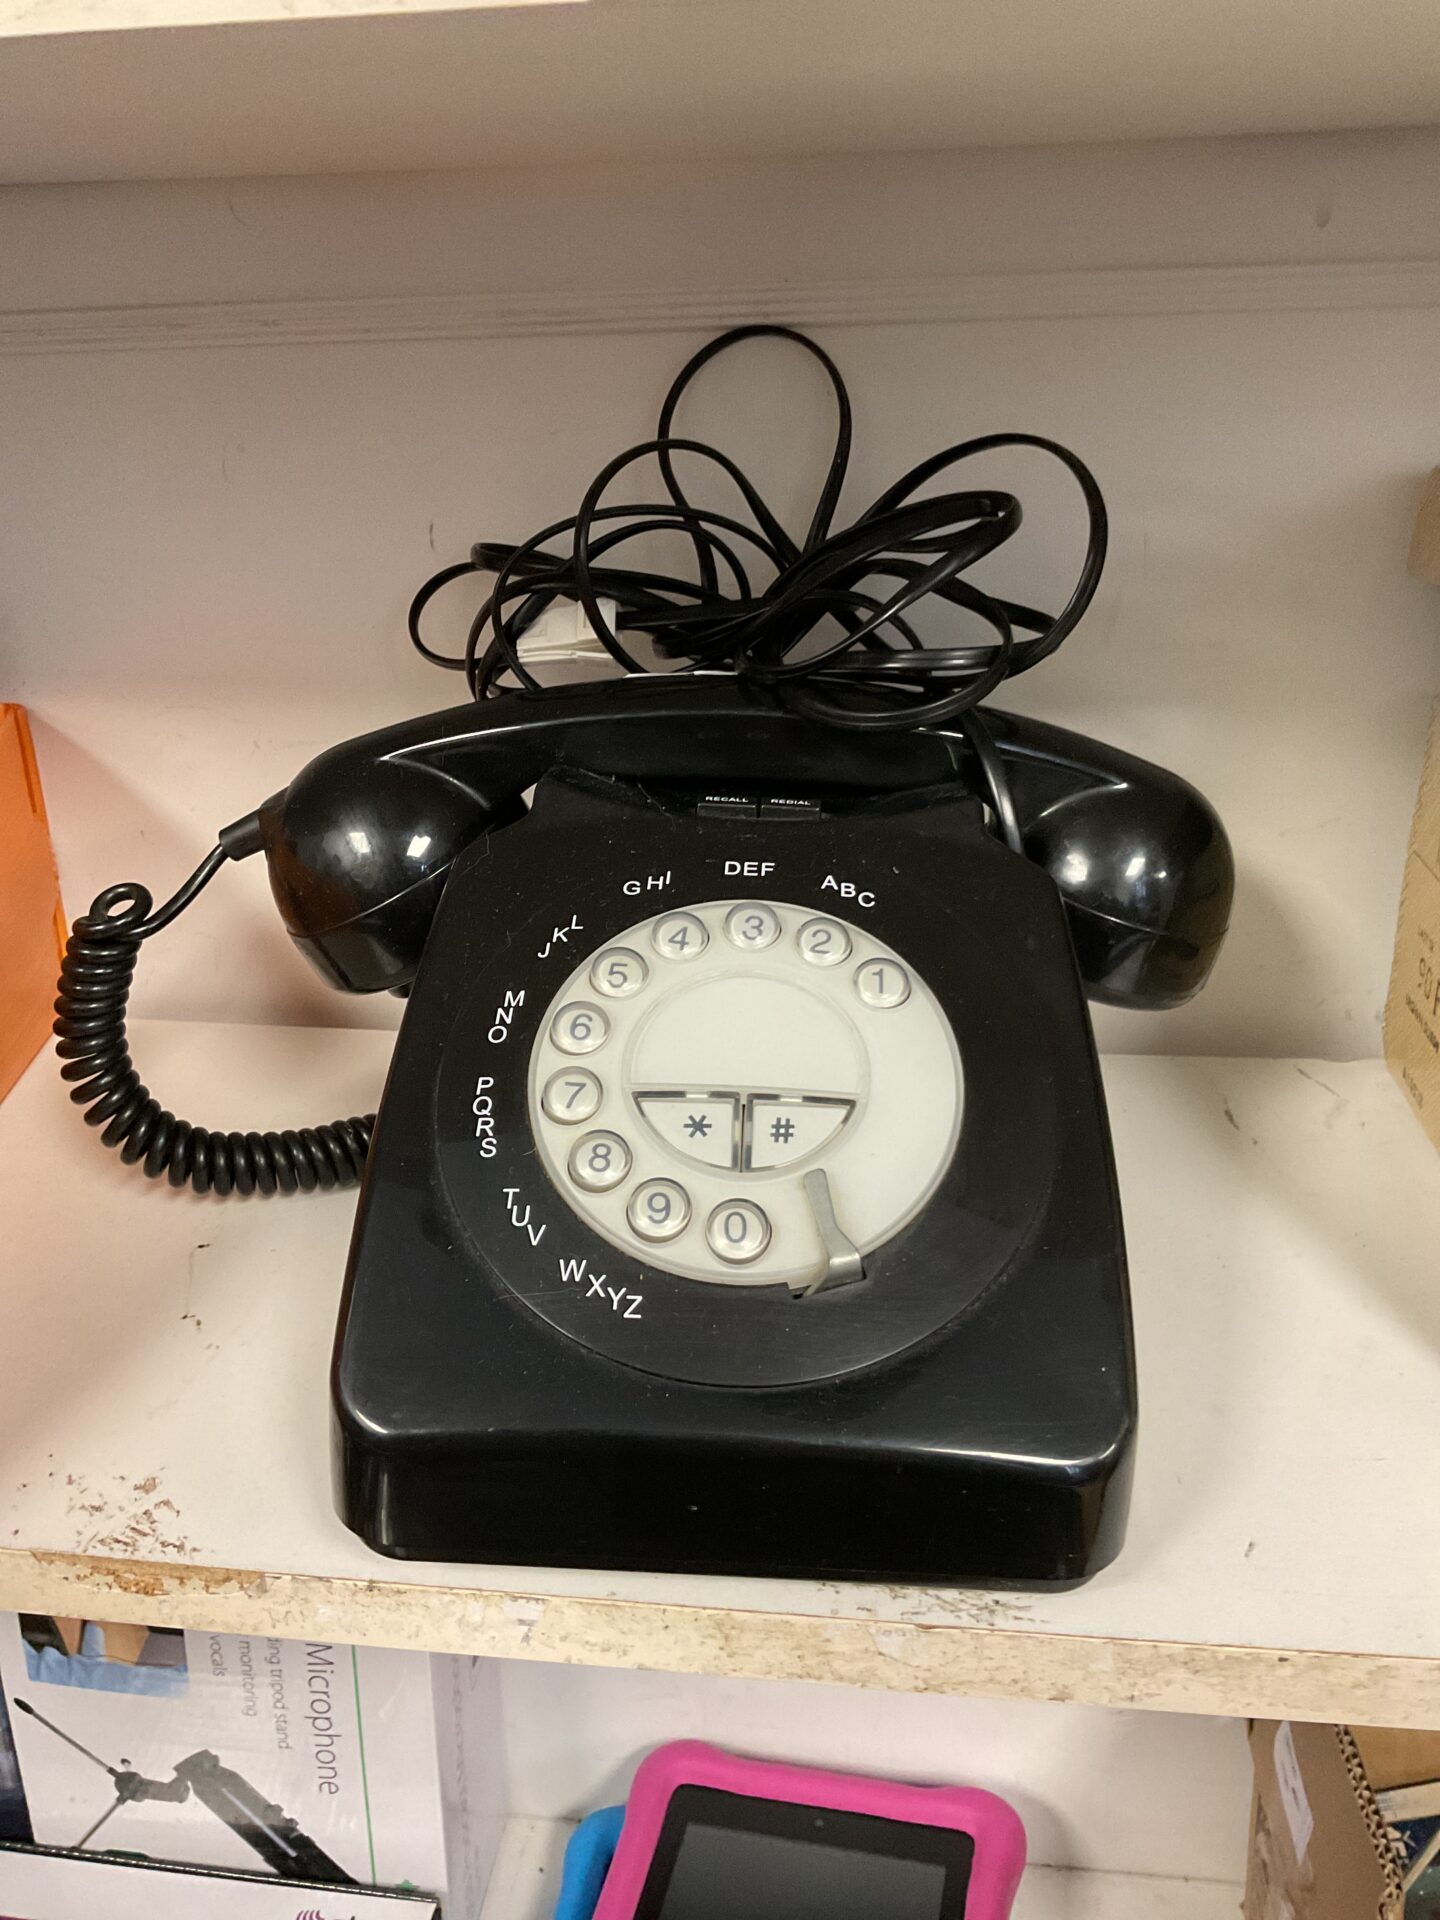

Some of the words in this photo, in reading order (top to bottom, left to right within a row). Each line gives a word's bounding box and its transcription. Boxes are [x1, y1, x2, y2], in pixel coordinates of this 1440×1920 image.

[770, 798, 811, 806] REDIAL
[622, 870, 671, 896] GHI
[724, 860, 776, 877] DEF
[820, 874, 876, 908] ABC
[537, 914, 584, 959] JKL
[667, 926, 690, 950] 4
[743, 915, 765, 940] 3
[810, 929, 832, 955] 2
[606, 962, 628, 989] 5
[871, 968, 887, 995] 1
[487, 989, 526, 1044] MNO
[568, 1013, 593, 1041] 6
[563, 1081, 587, 1109] 7
[472, 1076, 498, 1158] PQRS
[588, 1142, 613, 1173] 8
[502, 1188, 547, 1246] TUV
[646, 1192, 672, 1225] 9
[559, 1258, 643, 1319] WXYZ
[209, 1635, 228, 1677] vocals
[240, 1640, 259, 1717] monitoring
[269, 1668, 289, 1710] tripod
[274, 1713, 293, 1750] stand
[304, 1643, 342, 1794] Microphone
